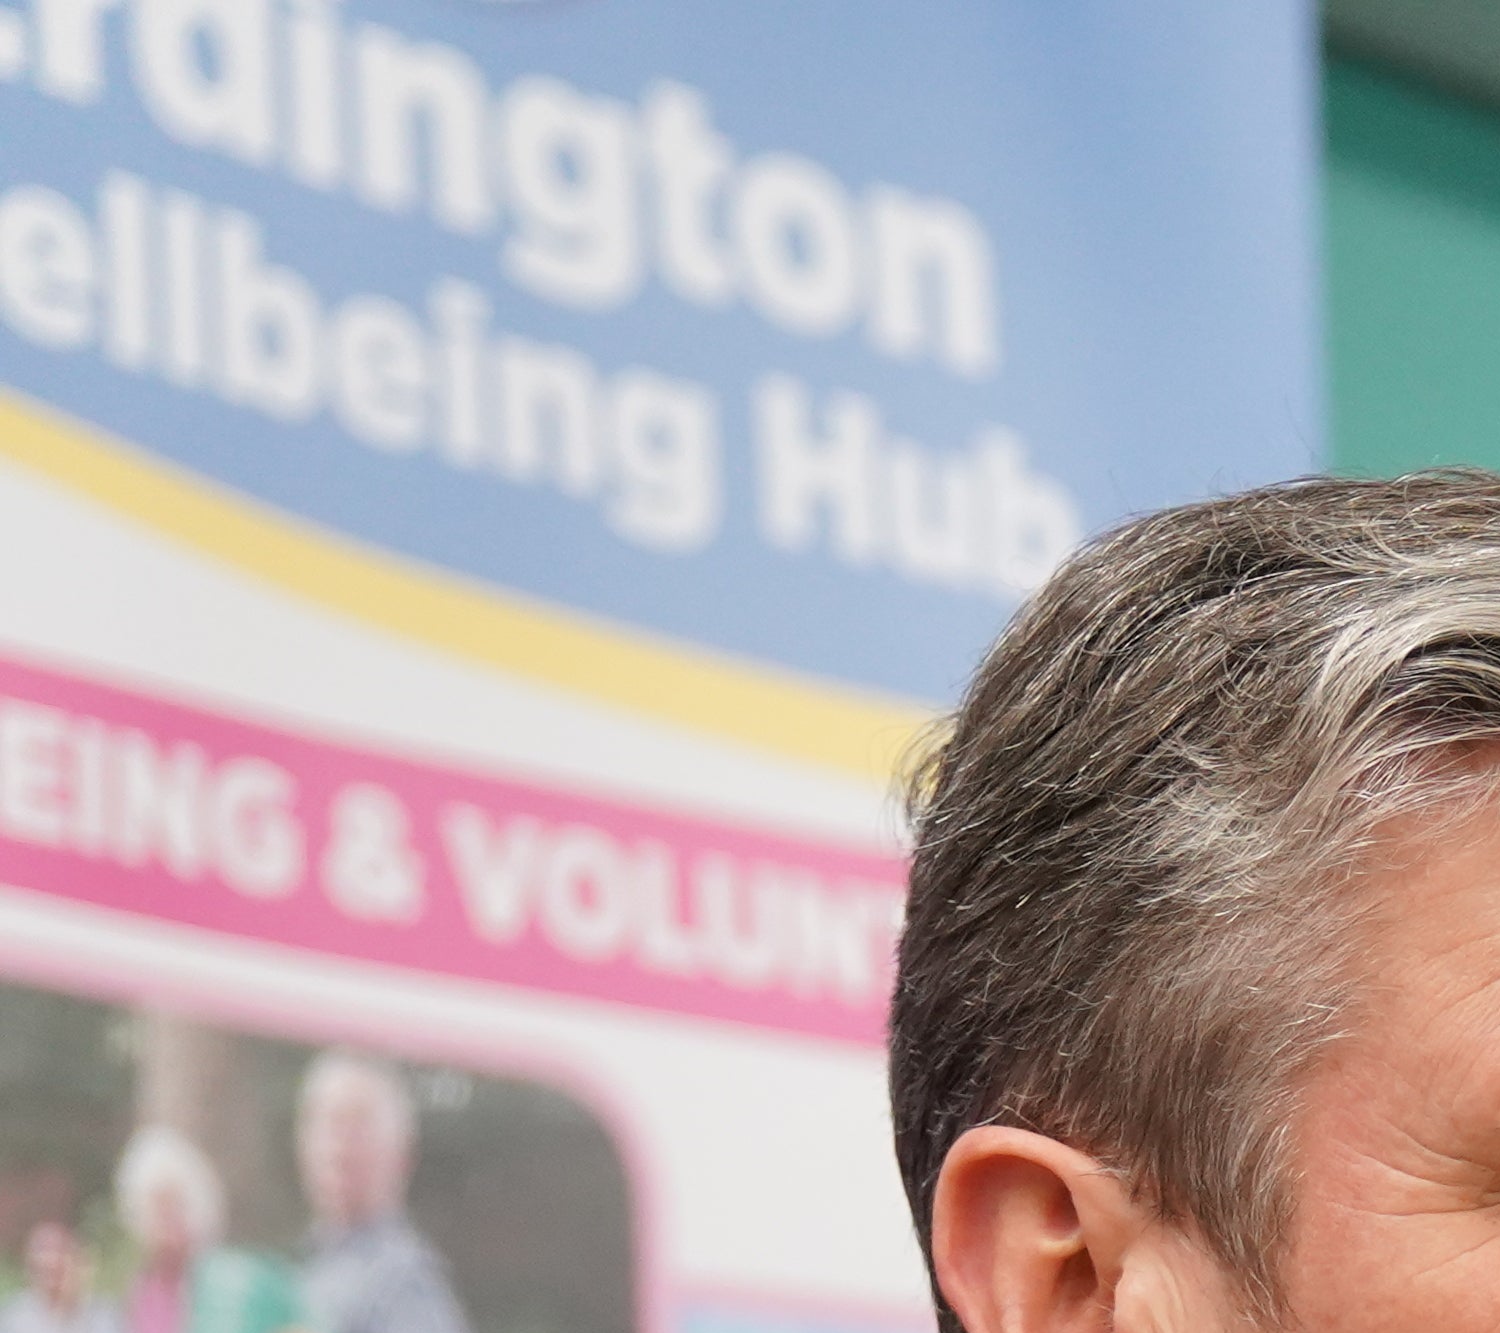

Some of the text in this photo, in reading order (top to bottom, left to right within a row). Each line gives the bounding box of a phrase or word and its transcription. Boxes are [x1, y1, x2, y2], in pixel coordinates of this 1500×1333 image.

[0, 0, 996, 380] rdington
[752, 375, 1082, 600] Hub
[320, 780, 430, 930] &
